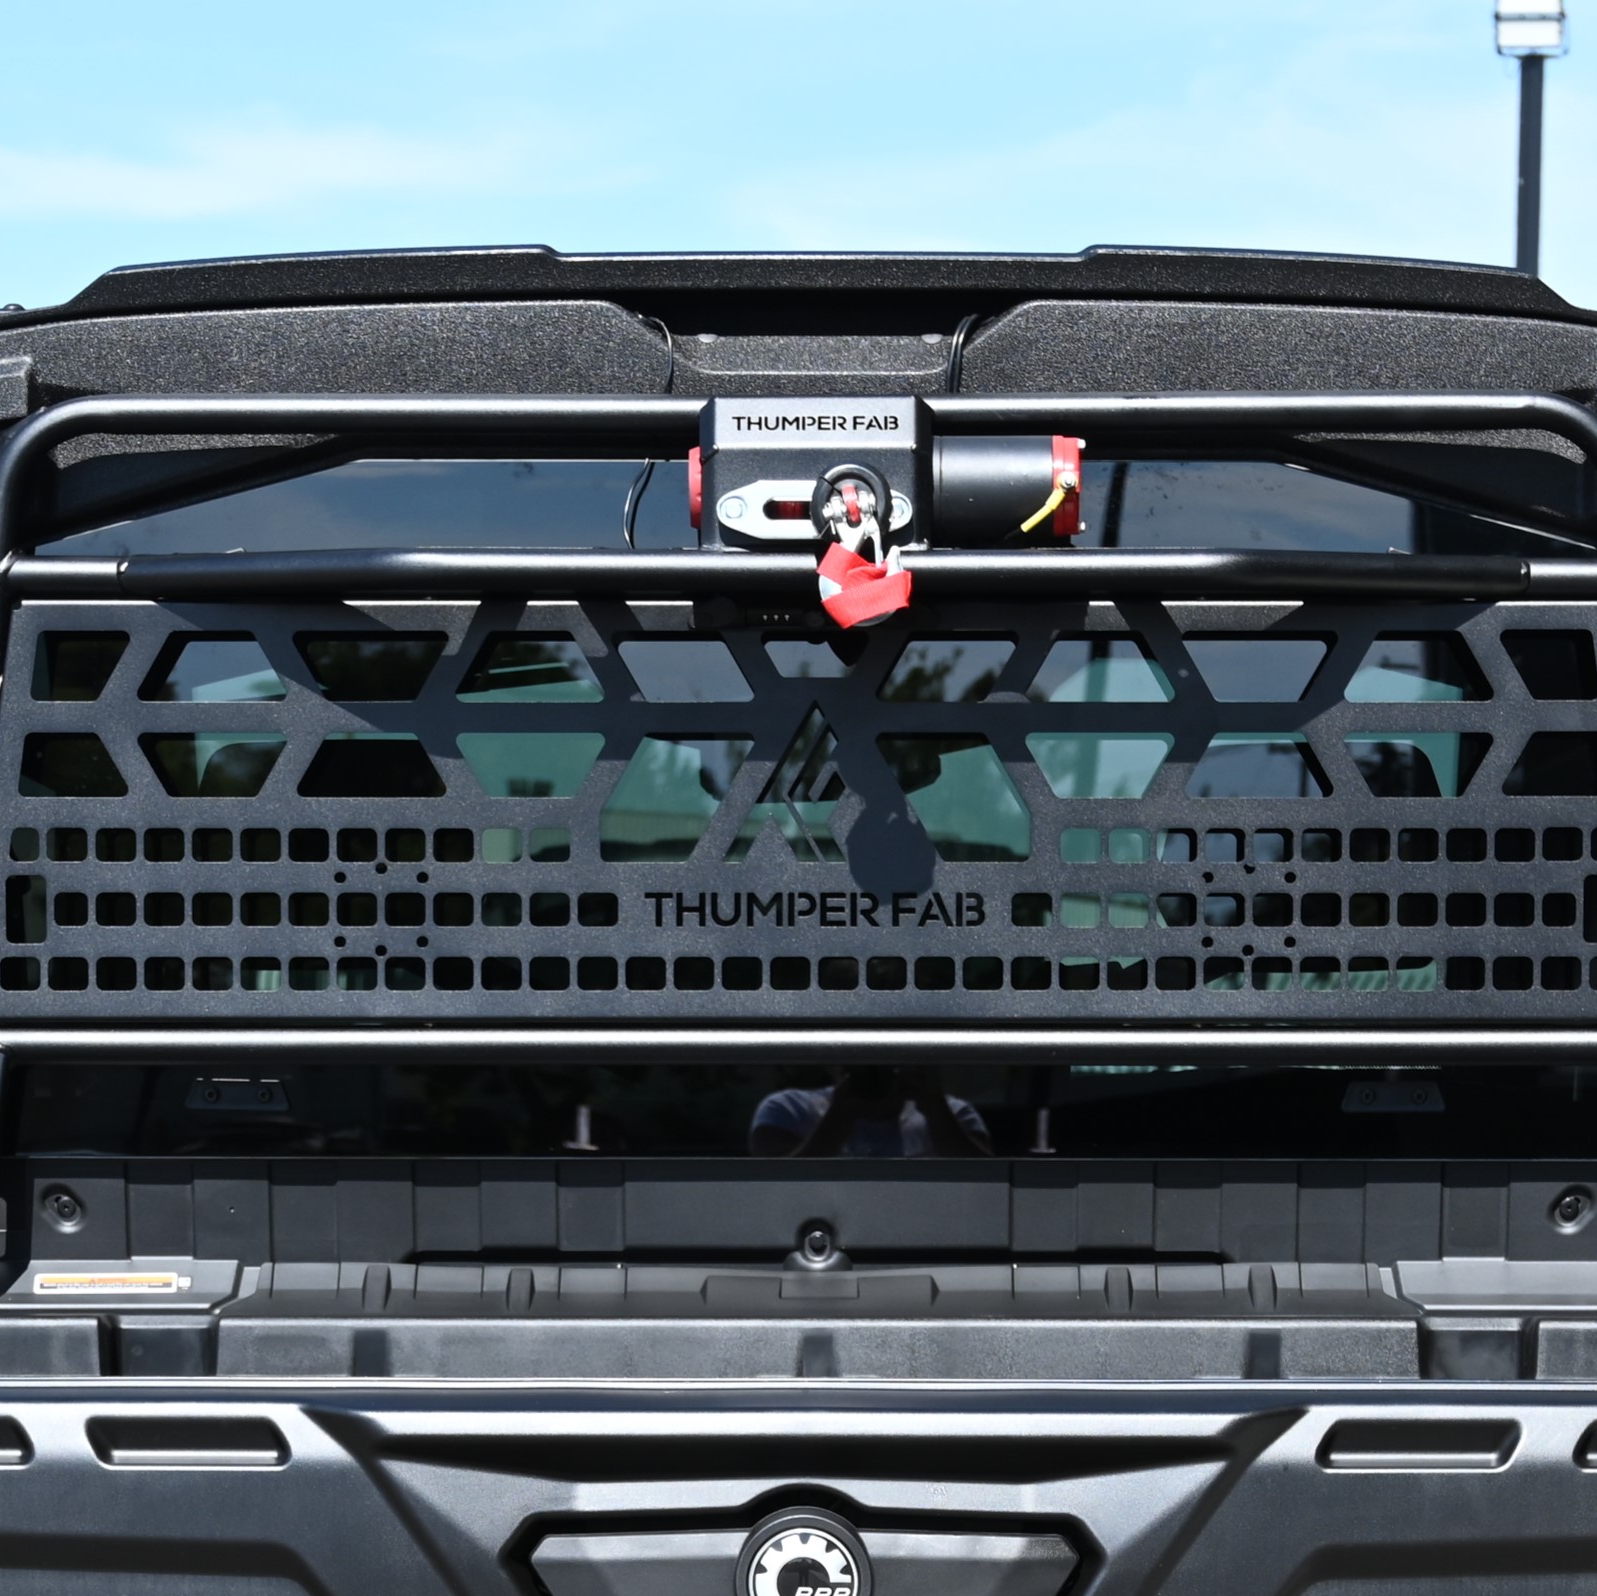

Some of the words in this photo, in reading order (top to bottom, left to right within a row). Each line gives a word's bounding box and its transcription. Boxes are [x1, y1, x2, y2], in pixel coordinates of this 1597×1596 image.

[731, 415, 848, 431] THUMPER
[852, 415, 900, 431] FAB
[644, 891, 880, 928] THUMPER
[891, 891, 986, 928] FAB
